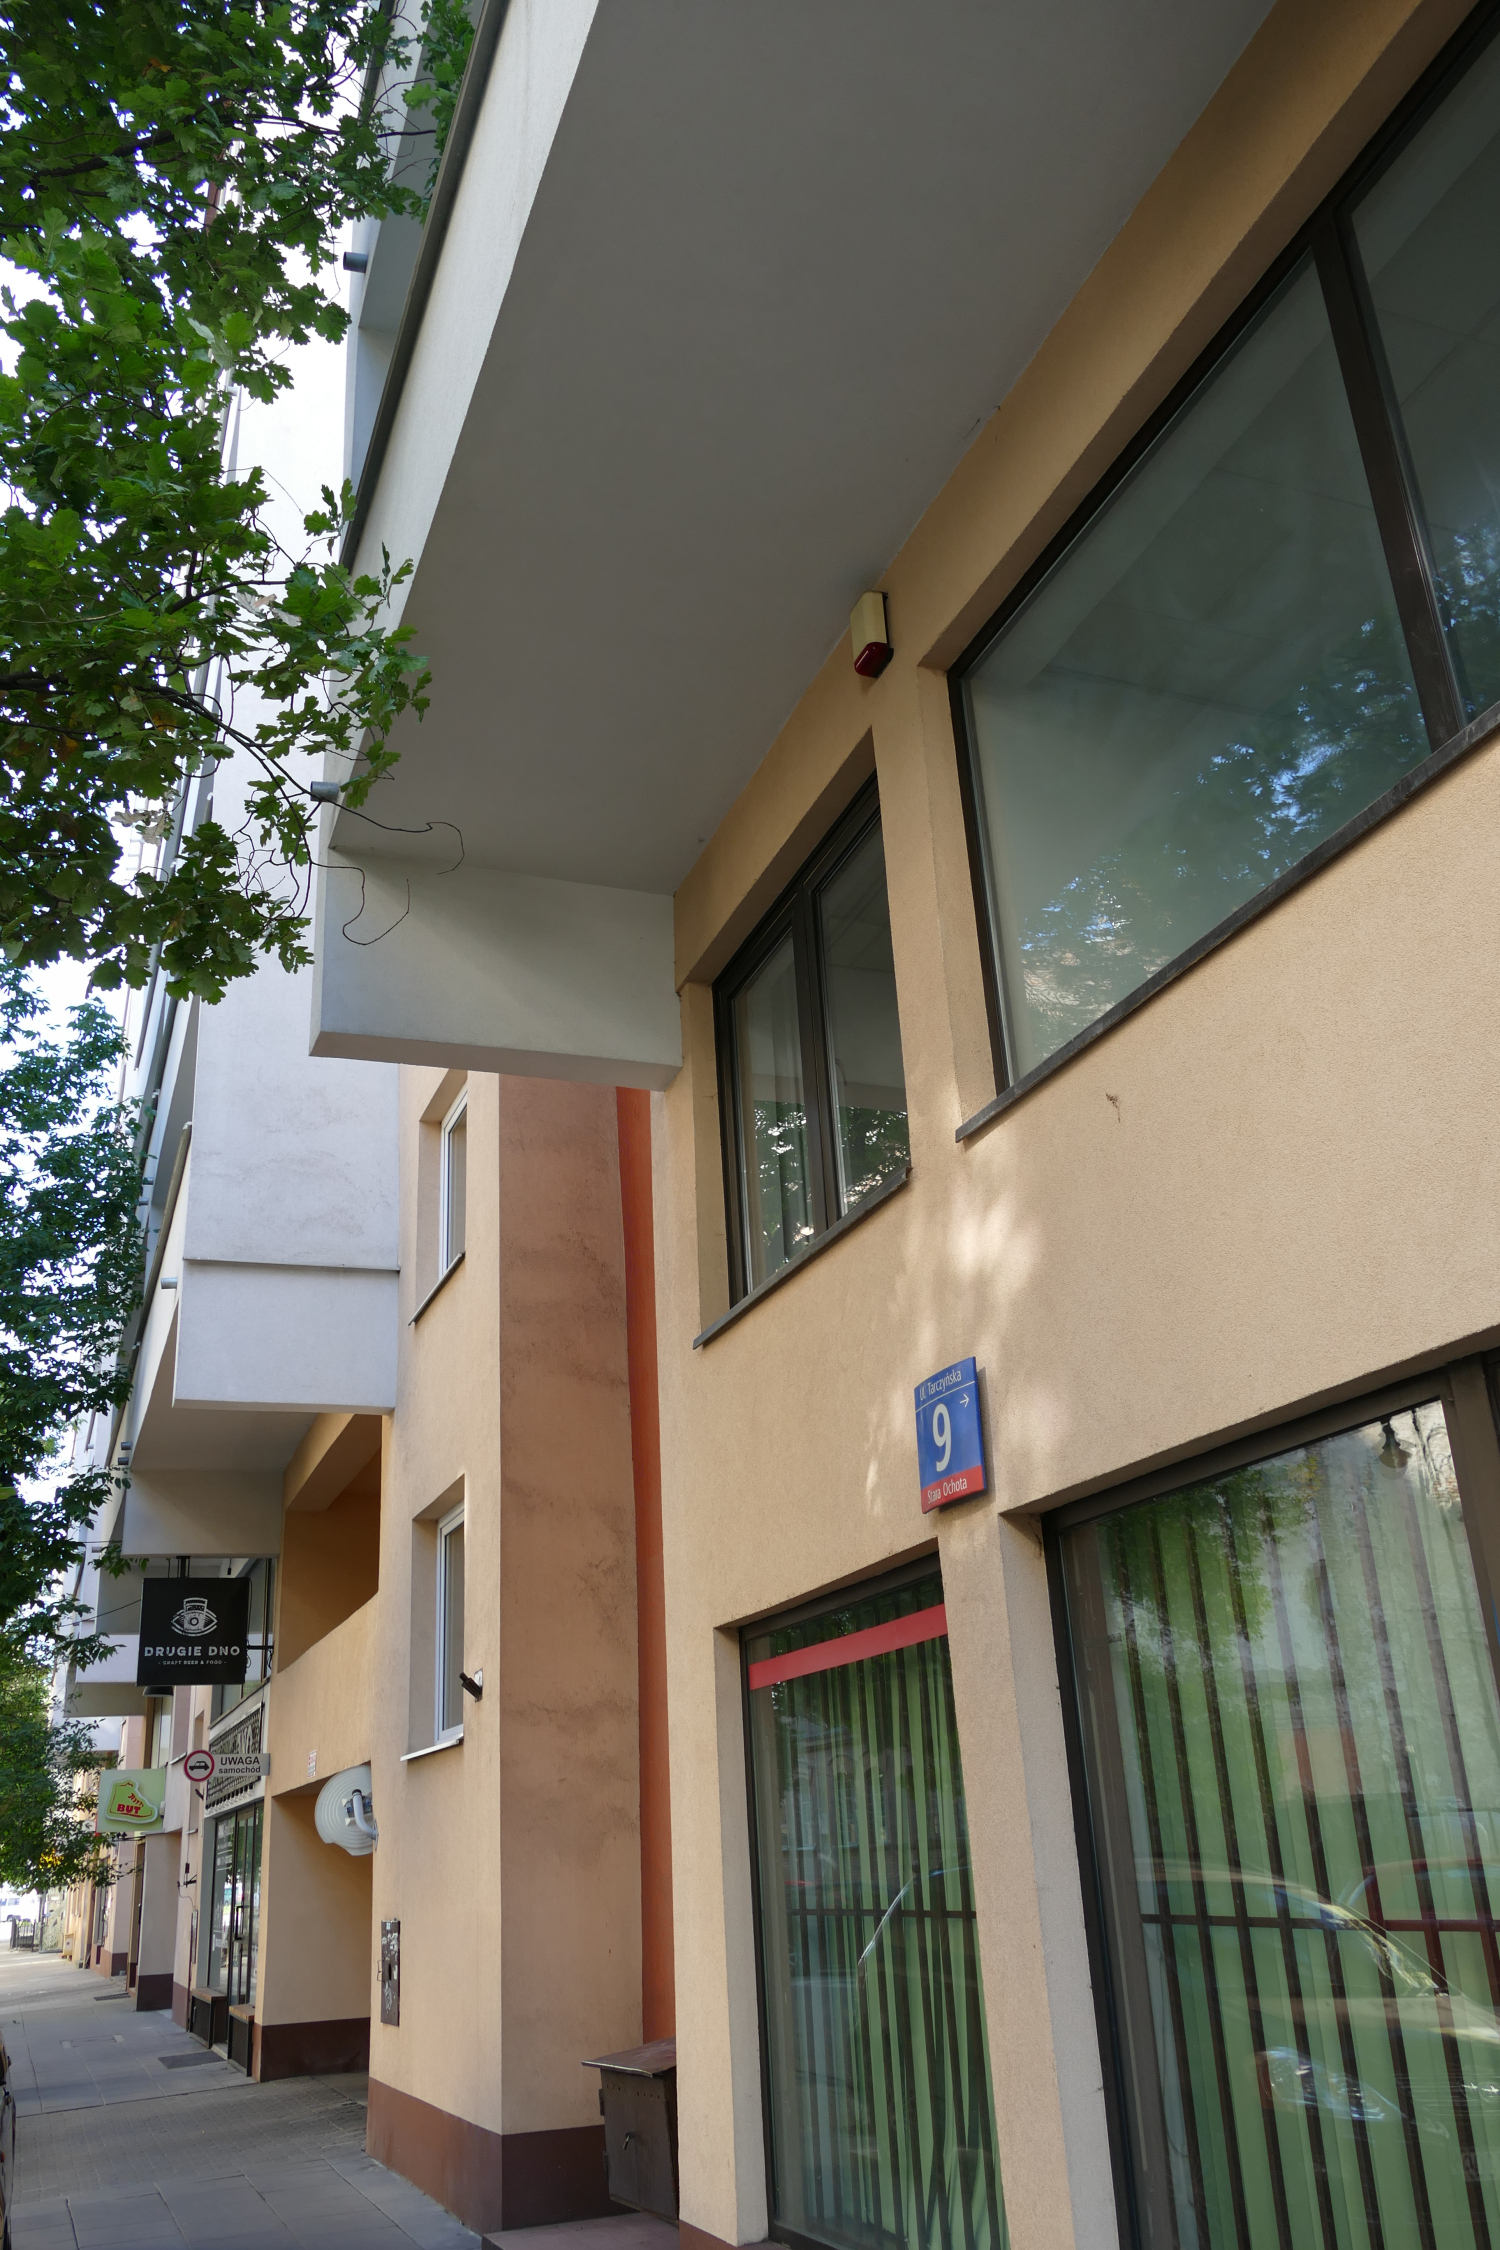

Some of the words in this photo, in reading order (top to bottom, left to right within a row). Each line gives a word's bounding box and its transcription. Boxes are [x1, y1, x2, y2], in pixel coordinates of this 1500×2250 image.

[927, 1369, 962, 1396] Tarczyńska
[932, 1403, 952, 1472] 9
[928, 1489, 941, 1503] Stara
[943, 1478, 967, 1496] Ochota
[144, 1646, 202, 1657] DRUGIE
[208, 1646, 240, 1656] DNO
[220, 1756, 260, 1766] UWAGA
[219, 1765, 261, 1774] samochód
[117, 1804, 141, 1814] BUT
